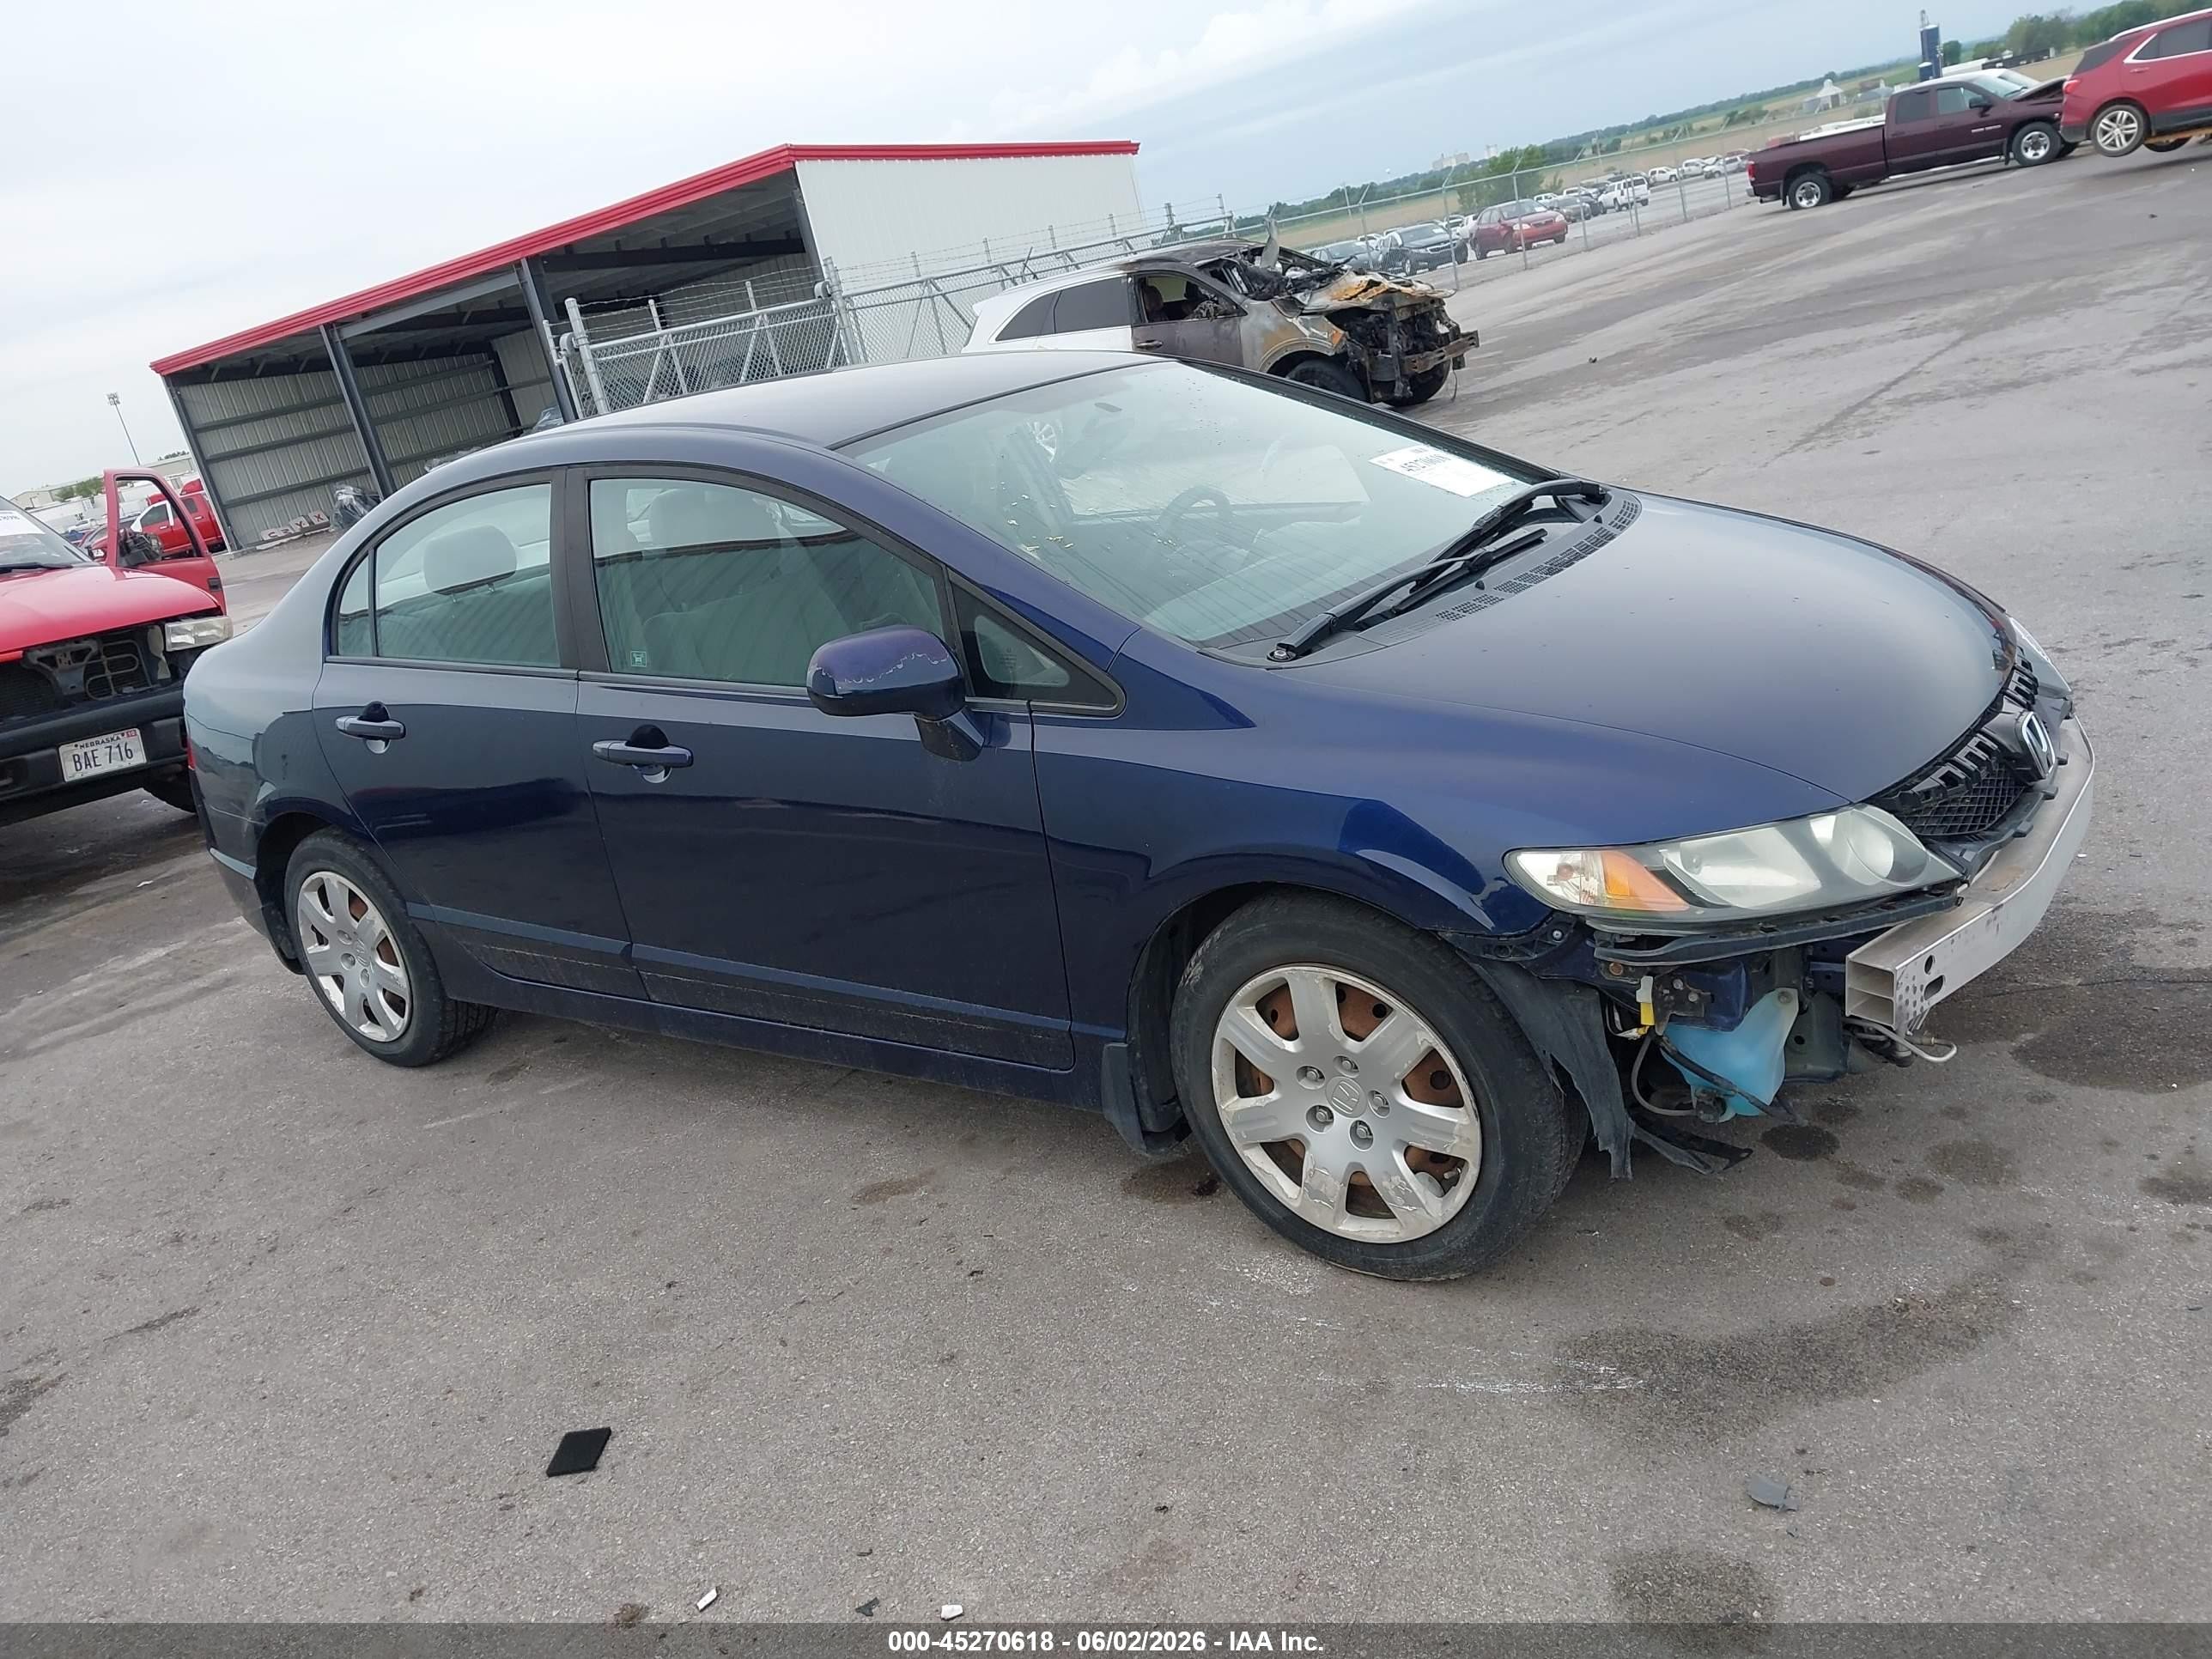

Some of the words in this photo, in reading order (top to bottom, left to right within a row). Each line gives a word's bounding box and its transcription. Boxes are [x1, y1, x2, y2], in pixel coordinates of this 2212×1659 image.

[1400, 453, 1451, 471] 4527
[80, 735, 121, 749] NEBRASKA
[72, 749, 101, 772] BAE
[105, 742, 134, 763] 716
